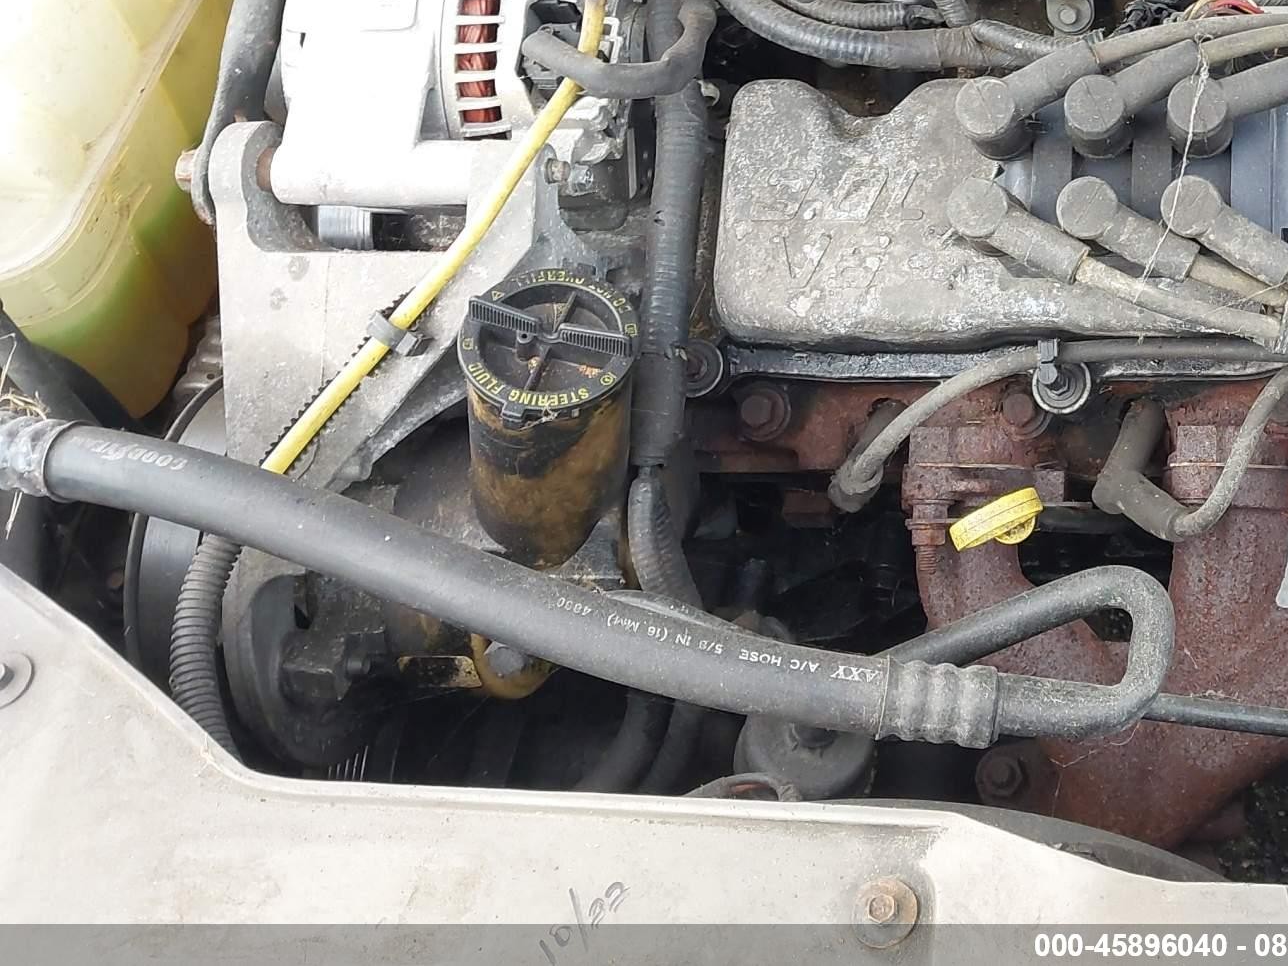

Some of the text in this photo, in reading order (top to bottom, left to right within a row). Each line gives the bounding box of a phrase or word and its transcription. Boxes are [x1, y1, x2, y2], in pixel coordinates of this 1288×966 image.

[467, 362, 590, 407] STEERING FLUID
[675, 634, 693, 646] IN
[738, 648, 783, 667] HOSE
[789, 659, 821, 673] A/C
